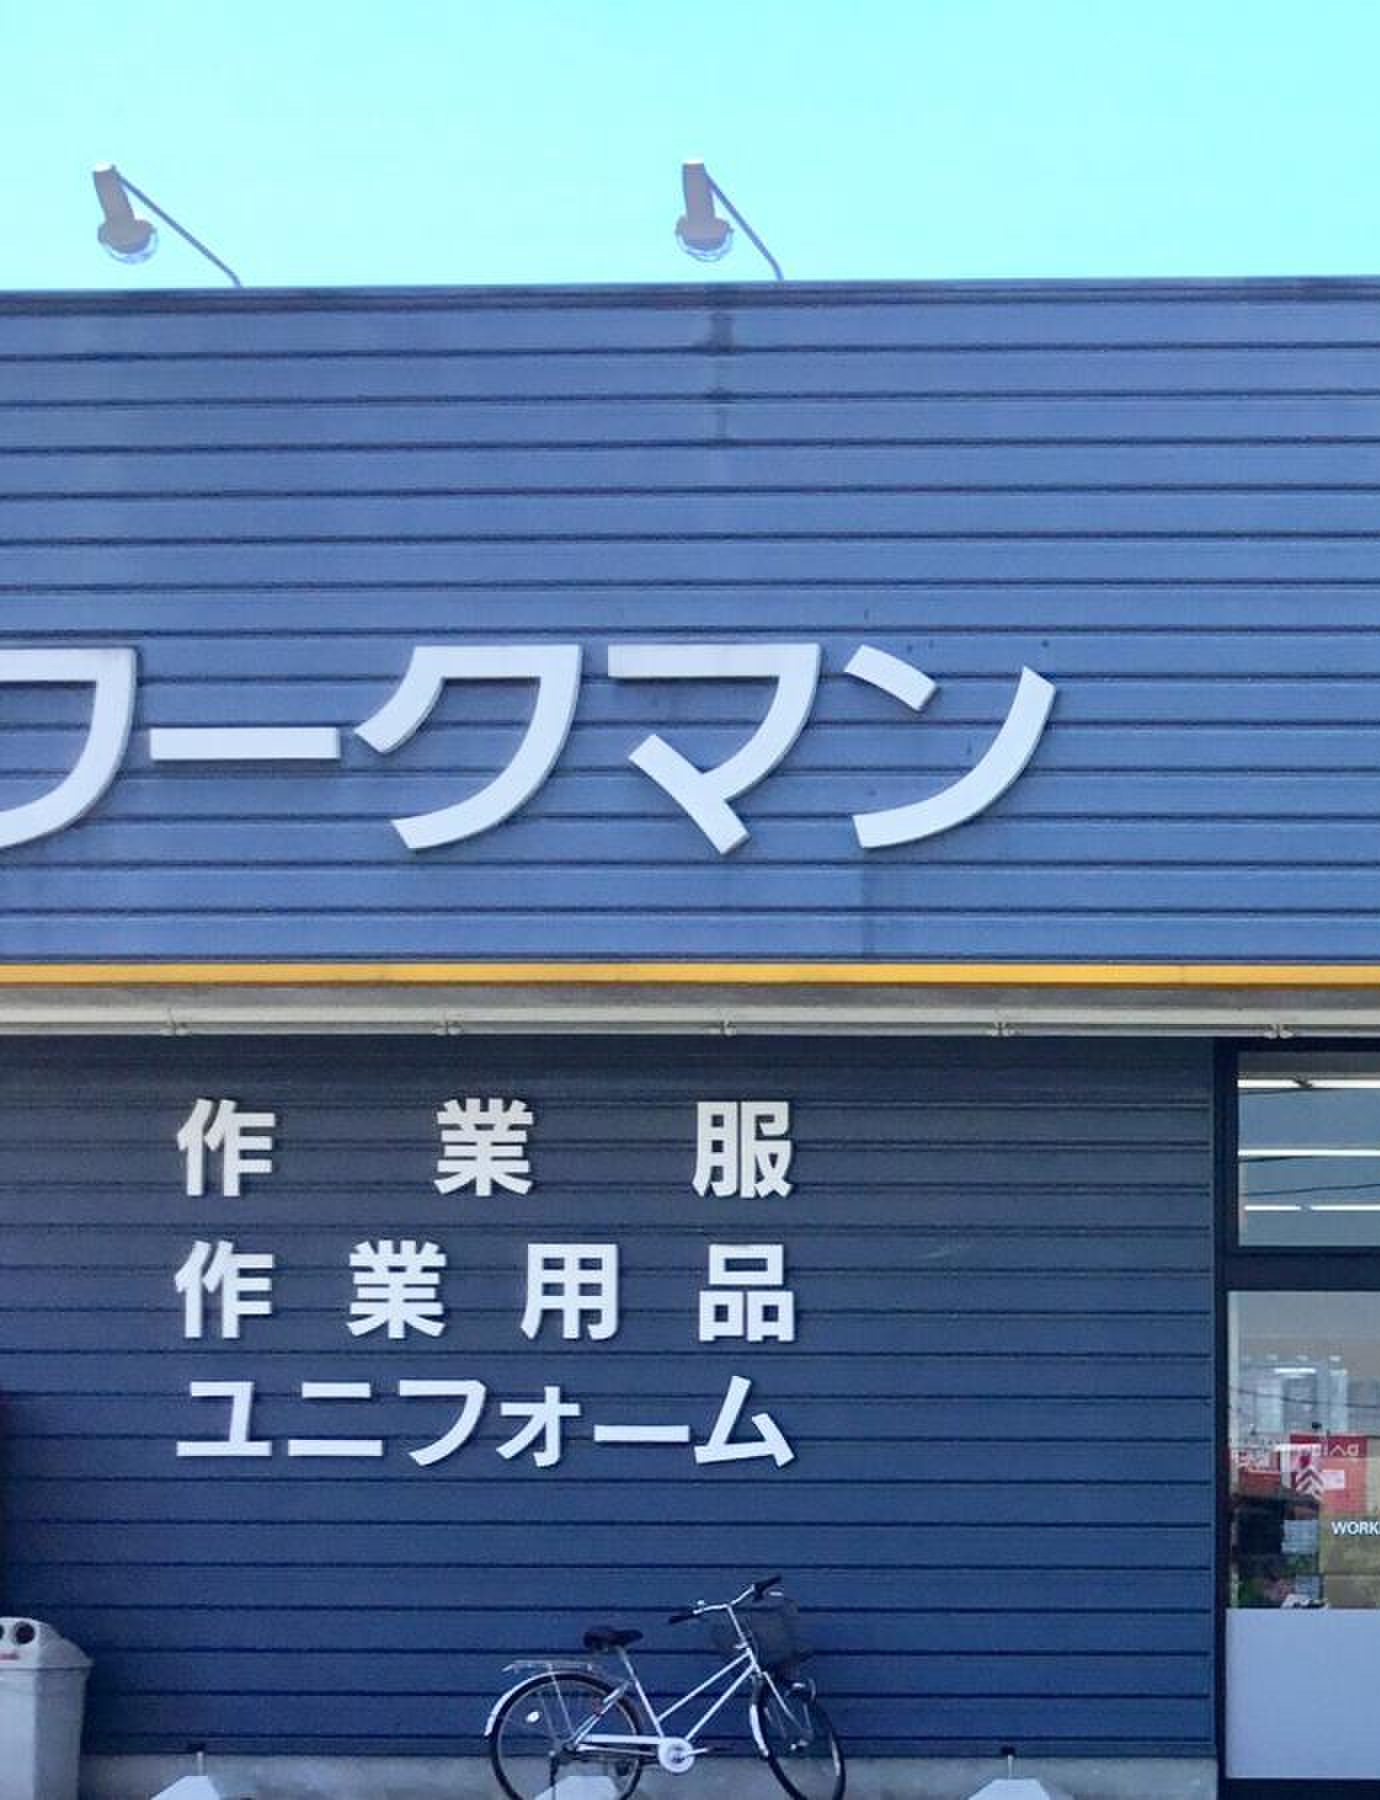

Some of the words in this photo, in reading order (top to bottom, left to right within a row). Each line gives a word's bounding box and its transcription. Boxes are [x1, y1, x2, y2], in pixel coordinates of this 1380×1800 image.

[175, 1097, 796, 1199] 作業服
[174, 1239, 796, 1342] 作業用品
[175, 1375, 796, 1467] ユニフォーム
